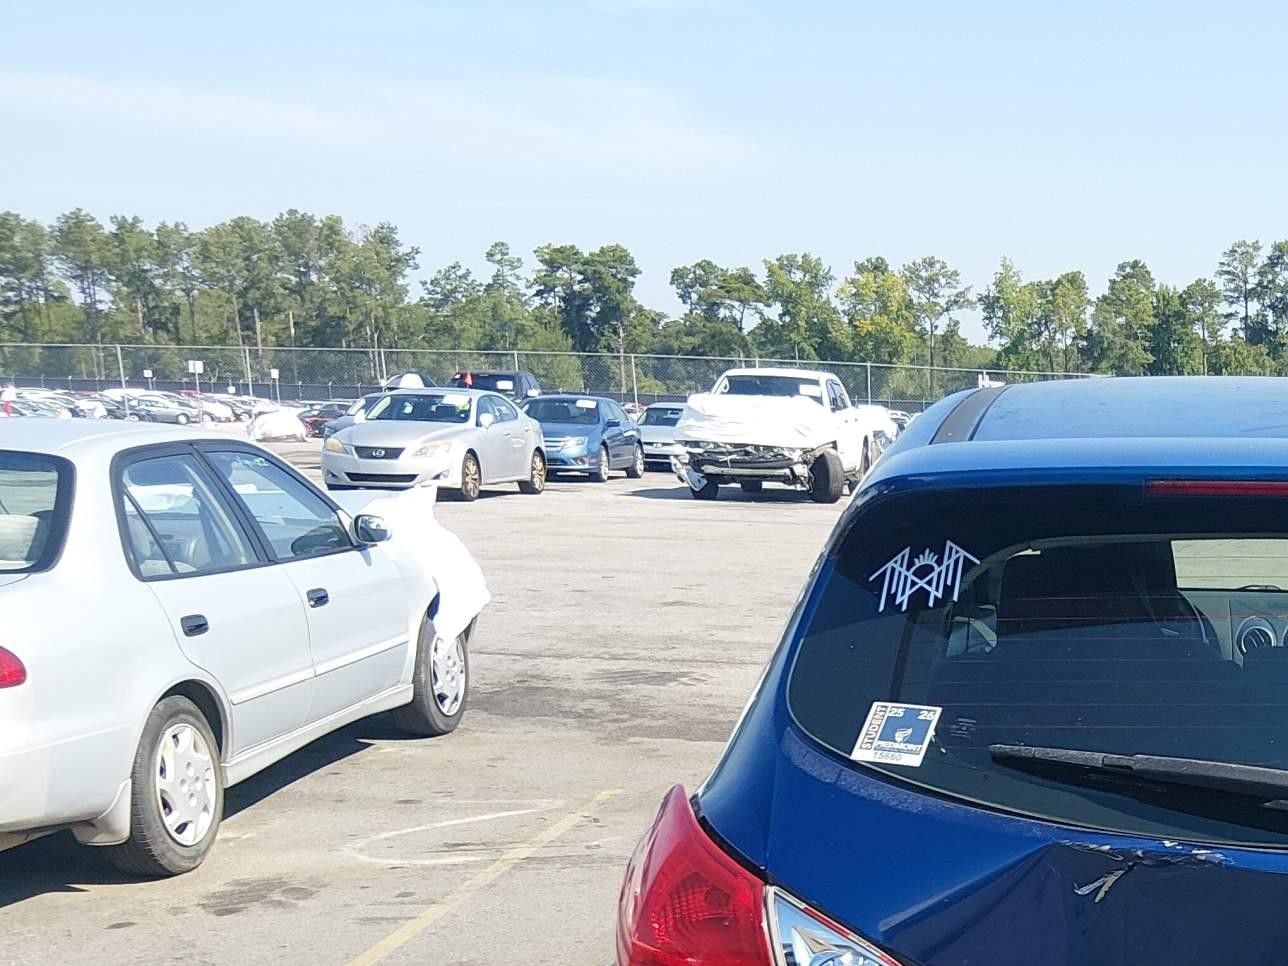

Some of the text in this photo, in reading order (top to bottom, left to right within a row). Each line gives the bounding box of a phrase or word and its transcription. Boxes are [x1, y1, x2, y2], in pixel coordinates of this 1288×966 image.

[888, 708, 905, 717] 25
[917, 710, 934, 720] 26
[860, 705, 888, 749] STUDENT
